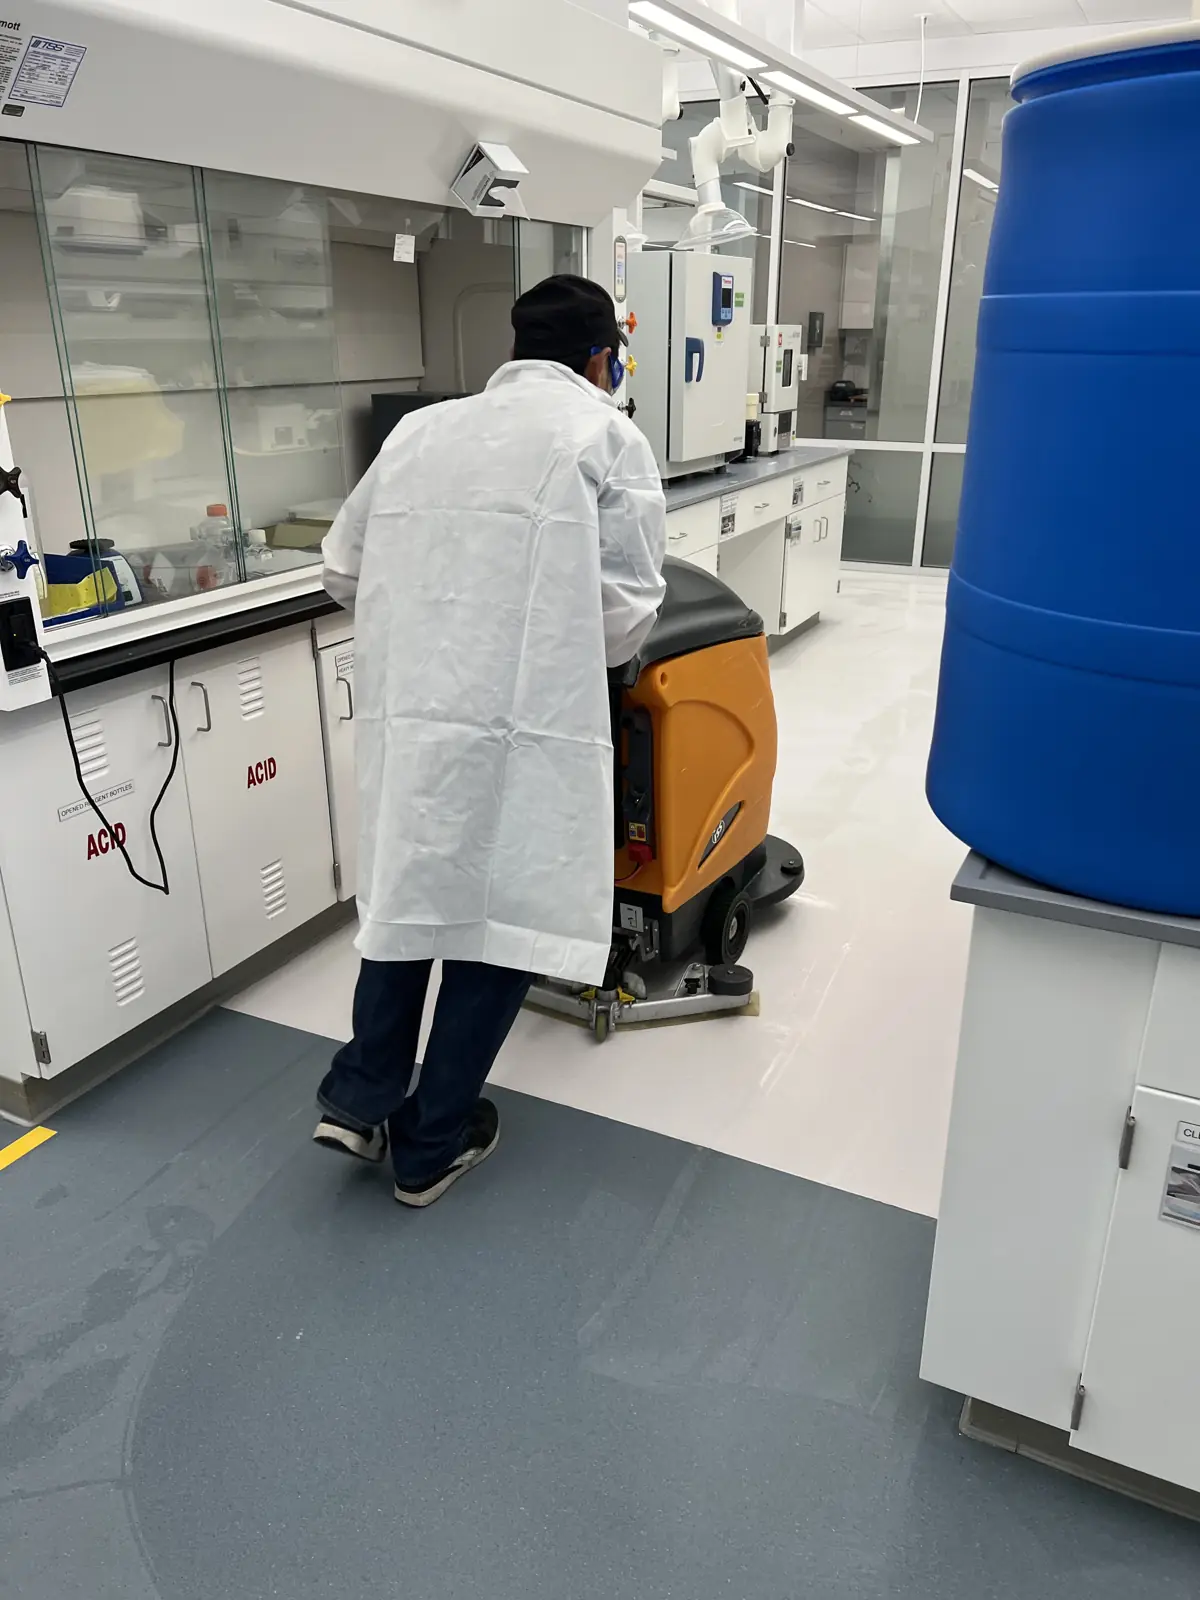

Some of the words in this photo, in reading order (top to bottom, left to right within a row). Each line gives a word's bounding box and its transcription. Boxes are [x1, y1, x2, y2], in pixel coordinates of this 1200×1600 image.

[247, 756, 277, 789] ACID
[61, 803, 84, 817] OPENED
[84, 793, 109, 809] RGENT
[109, 783, 133, 796] BOTTLES
[87, 822, 127, 861] ACID
